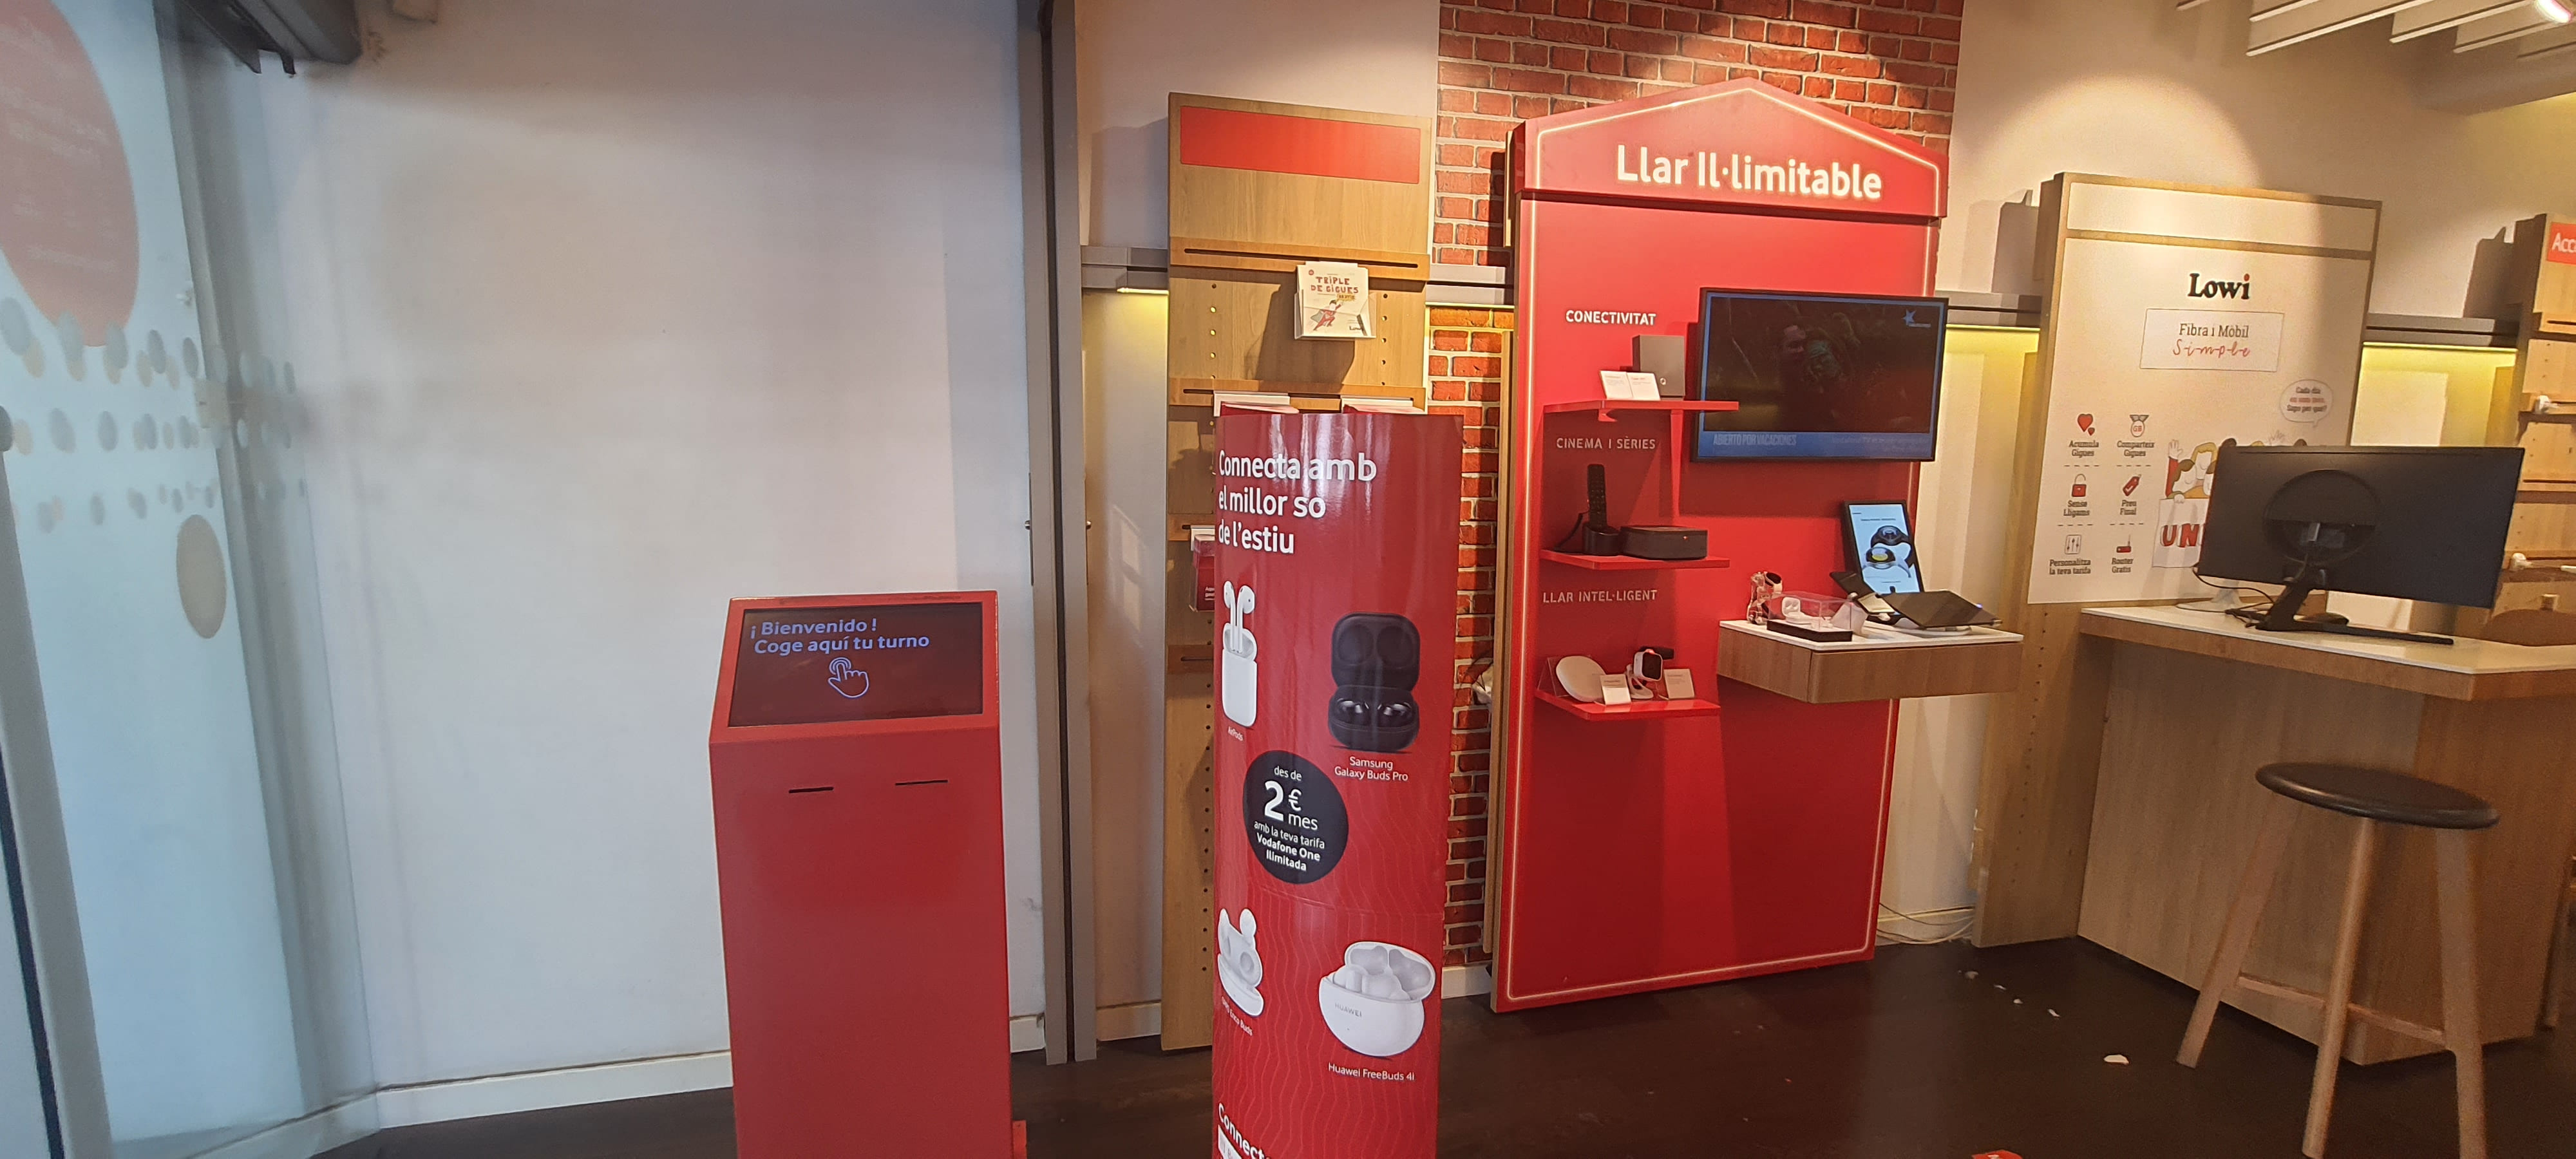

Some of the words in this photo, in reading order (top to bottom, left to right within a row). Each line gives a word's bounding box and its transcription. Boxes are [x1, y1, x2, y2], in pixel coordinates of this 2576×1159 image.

[1617, 145, 1689, 184] Llar
[1698, 151, 1882, 198] Il·limitable
[2552, 232, 2576, 253] Acc
[2187, 273, 2250, 299] Lowi
[1566, 310, 1656, 325] CONECTIVITAT
[2179, 323, 2209, 336] Fibra
[1557, 437, 1602, 449] CINEMA
[1616, 436, 1656, 449] SÈRIES
[1219, 450, 1301, 479] Connecta
[1308, 453, 1377, 482] amb
[1218, 485, 1227, 511] el
[1229, 487, 1288, 516] millor
[1293, 496, 1327, 518] so
[1218, 519, 1231, 545] de
[2161, 523, 2204, 547] UN
[1543, 592, 1573, 603] LLAR
[1578, 590, 1658, 602] INTEL·LIGENT
[750, 626, 756, 639] ¡
[761, 618, 867, 636] Bienvenido
[872, 618, 877, 632] !
[754, 639, 803, 656] Coge
[808, 636, 848, 654] aquí
[853, 637, 873, 649] tu
[878, 635, 930, 649] turno
[1274, 766, 1289, 778] des
[1291, 768, 1302, 781] de
[1334, 766, 1365, 780] Galaxy
[1367, 769, 1390, 780] Buds
[1392, 771, 1408, 782] Pro
[1349, 756, 1393, 771] Samsung
[1264, 780, 1284, 822] 2
[1289, 814, 1318, 831] mes
[1254, 820, 1269, 834] amb
[1271, 825, 1278, 837] la
[1280, 829, 1298, 843] teva
[1300, 835, 1325, 849] tarifa
[1256, 833, 1298, 856] Vodafone
[1299, 848, 1320, 862] One
[1266, 849, 1307, 871] Ilimitada
[1335, 1003, 1362, 1017] HUAWEI
[1240, 1019, 1253, 1036] Buds
[1328, 1062, 1360, 1077] Huawei
[1363, 1068, 1404, 1080] FreeBuds
[1218, 1102, 1272, 1159] Connect
